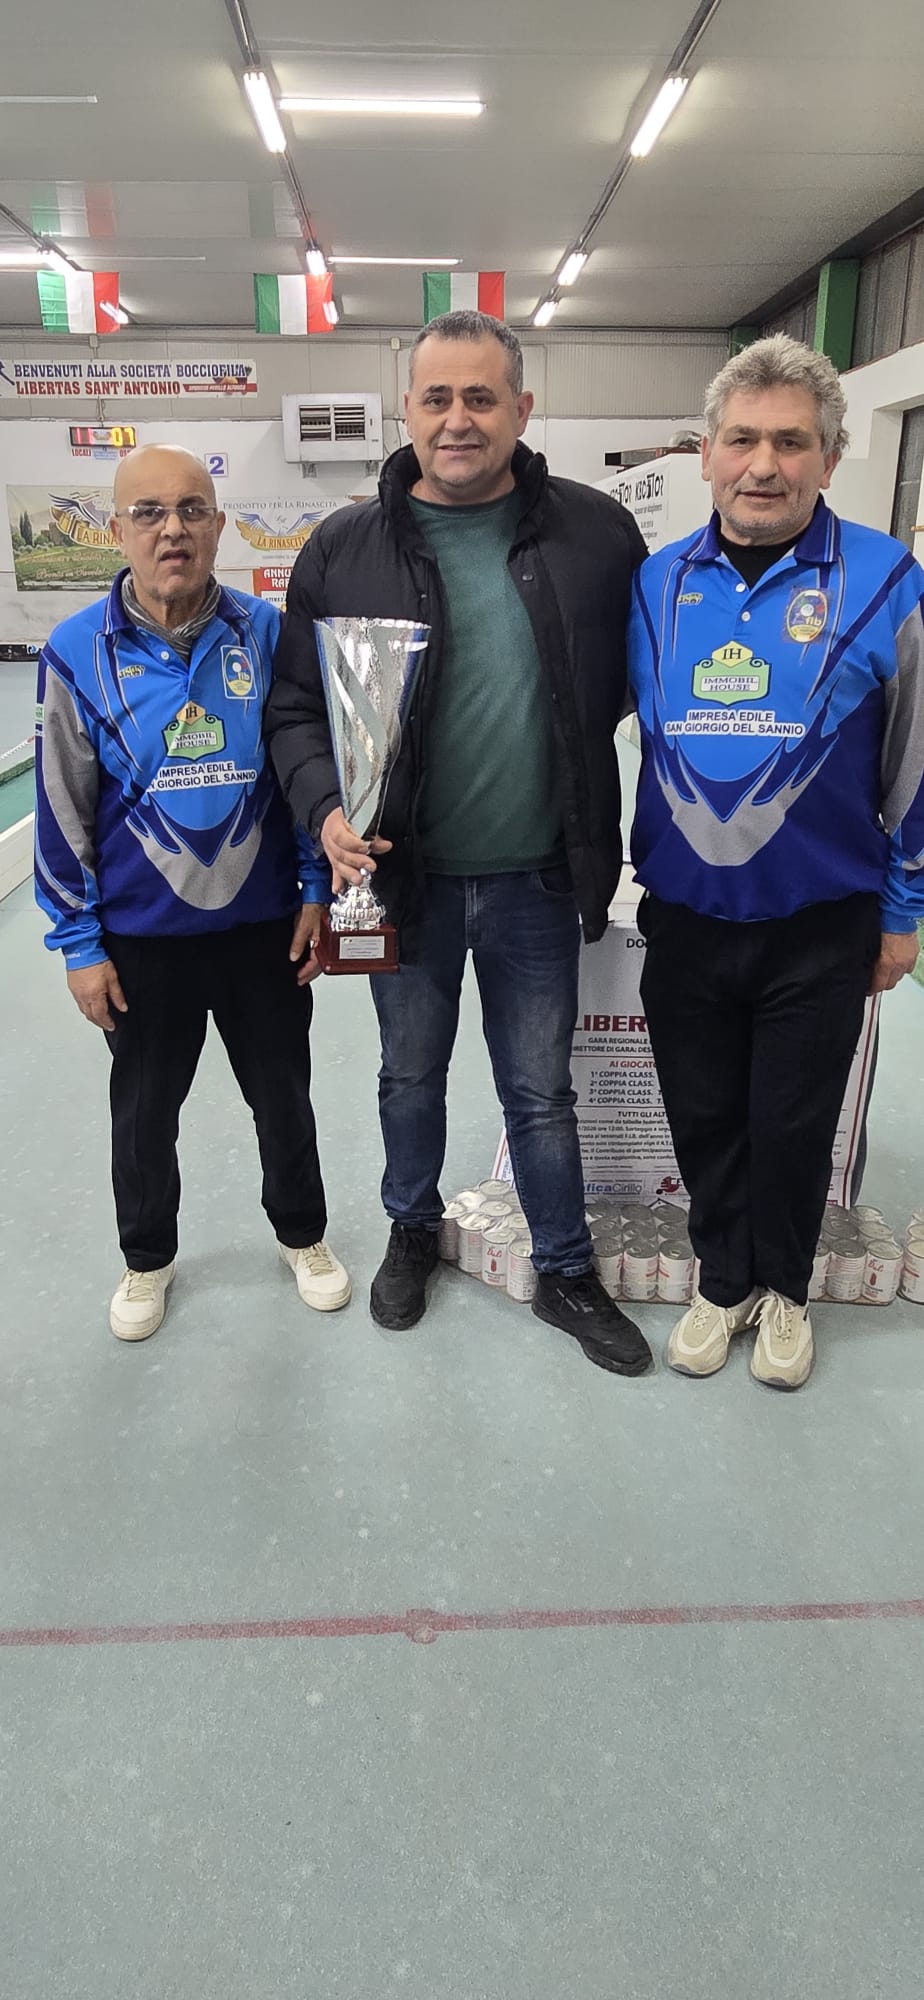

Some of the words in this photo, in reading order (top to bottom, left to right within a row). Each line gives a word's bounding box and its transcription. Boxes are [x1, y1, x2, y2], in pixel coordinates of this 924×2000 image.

[14, 364, 82, 377] BENVENUTI
[87, 364, 117, 377] ALLA
[120, 364, 172, 377] SOCIETA'
[176, 364, 246, 377] BOCCIOFILA
[16, 381, 80, 395] LIBERTAS
[85, 381, 180, 395] SANT'ANTONIO
[209, 456, 225, 474] 2
[77, 527, 89, 542] LA
[257, 536, 266, 546] LA
[722, 648, 742, 660] IH
[704, 677, 757, 685] IMMOBIL
[710, 684, 751, 692] HOUSE
[185, 706, 198, 718] IH
[688, 712, 737, 722] IMPRESA
[739, 712, 773, 722] EDILE
[666, 723, 683, 733] SAN
[684, 723, 730, 733] GIORGIO
[732, 723, 754, 733] DEL
[758, 724, 803, 735] SANNIO
[176, 739, 210, 749] HOUSE
[160, 765, 206, 778] IMPRESA
[207, 763, 233, 773] EDILE
[157, 776, 201, 789] GIORGIO
[203, 775, 222, 785] DEL
[223, 771, 256, 782] SANNIO
[626, 938, 648, 949] DO
